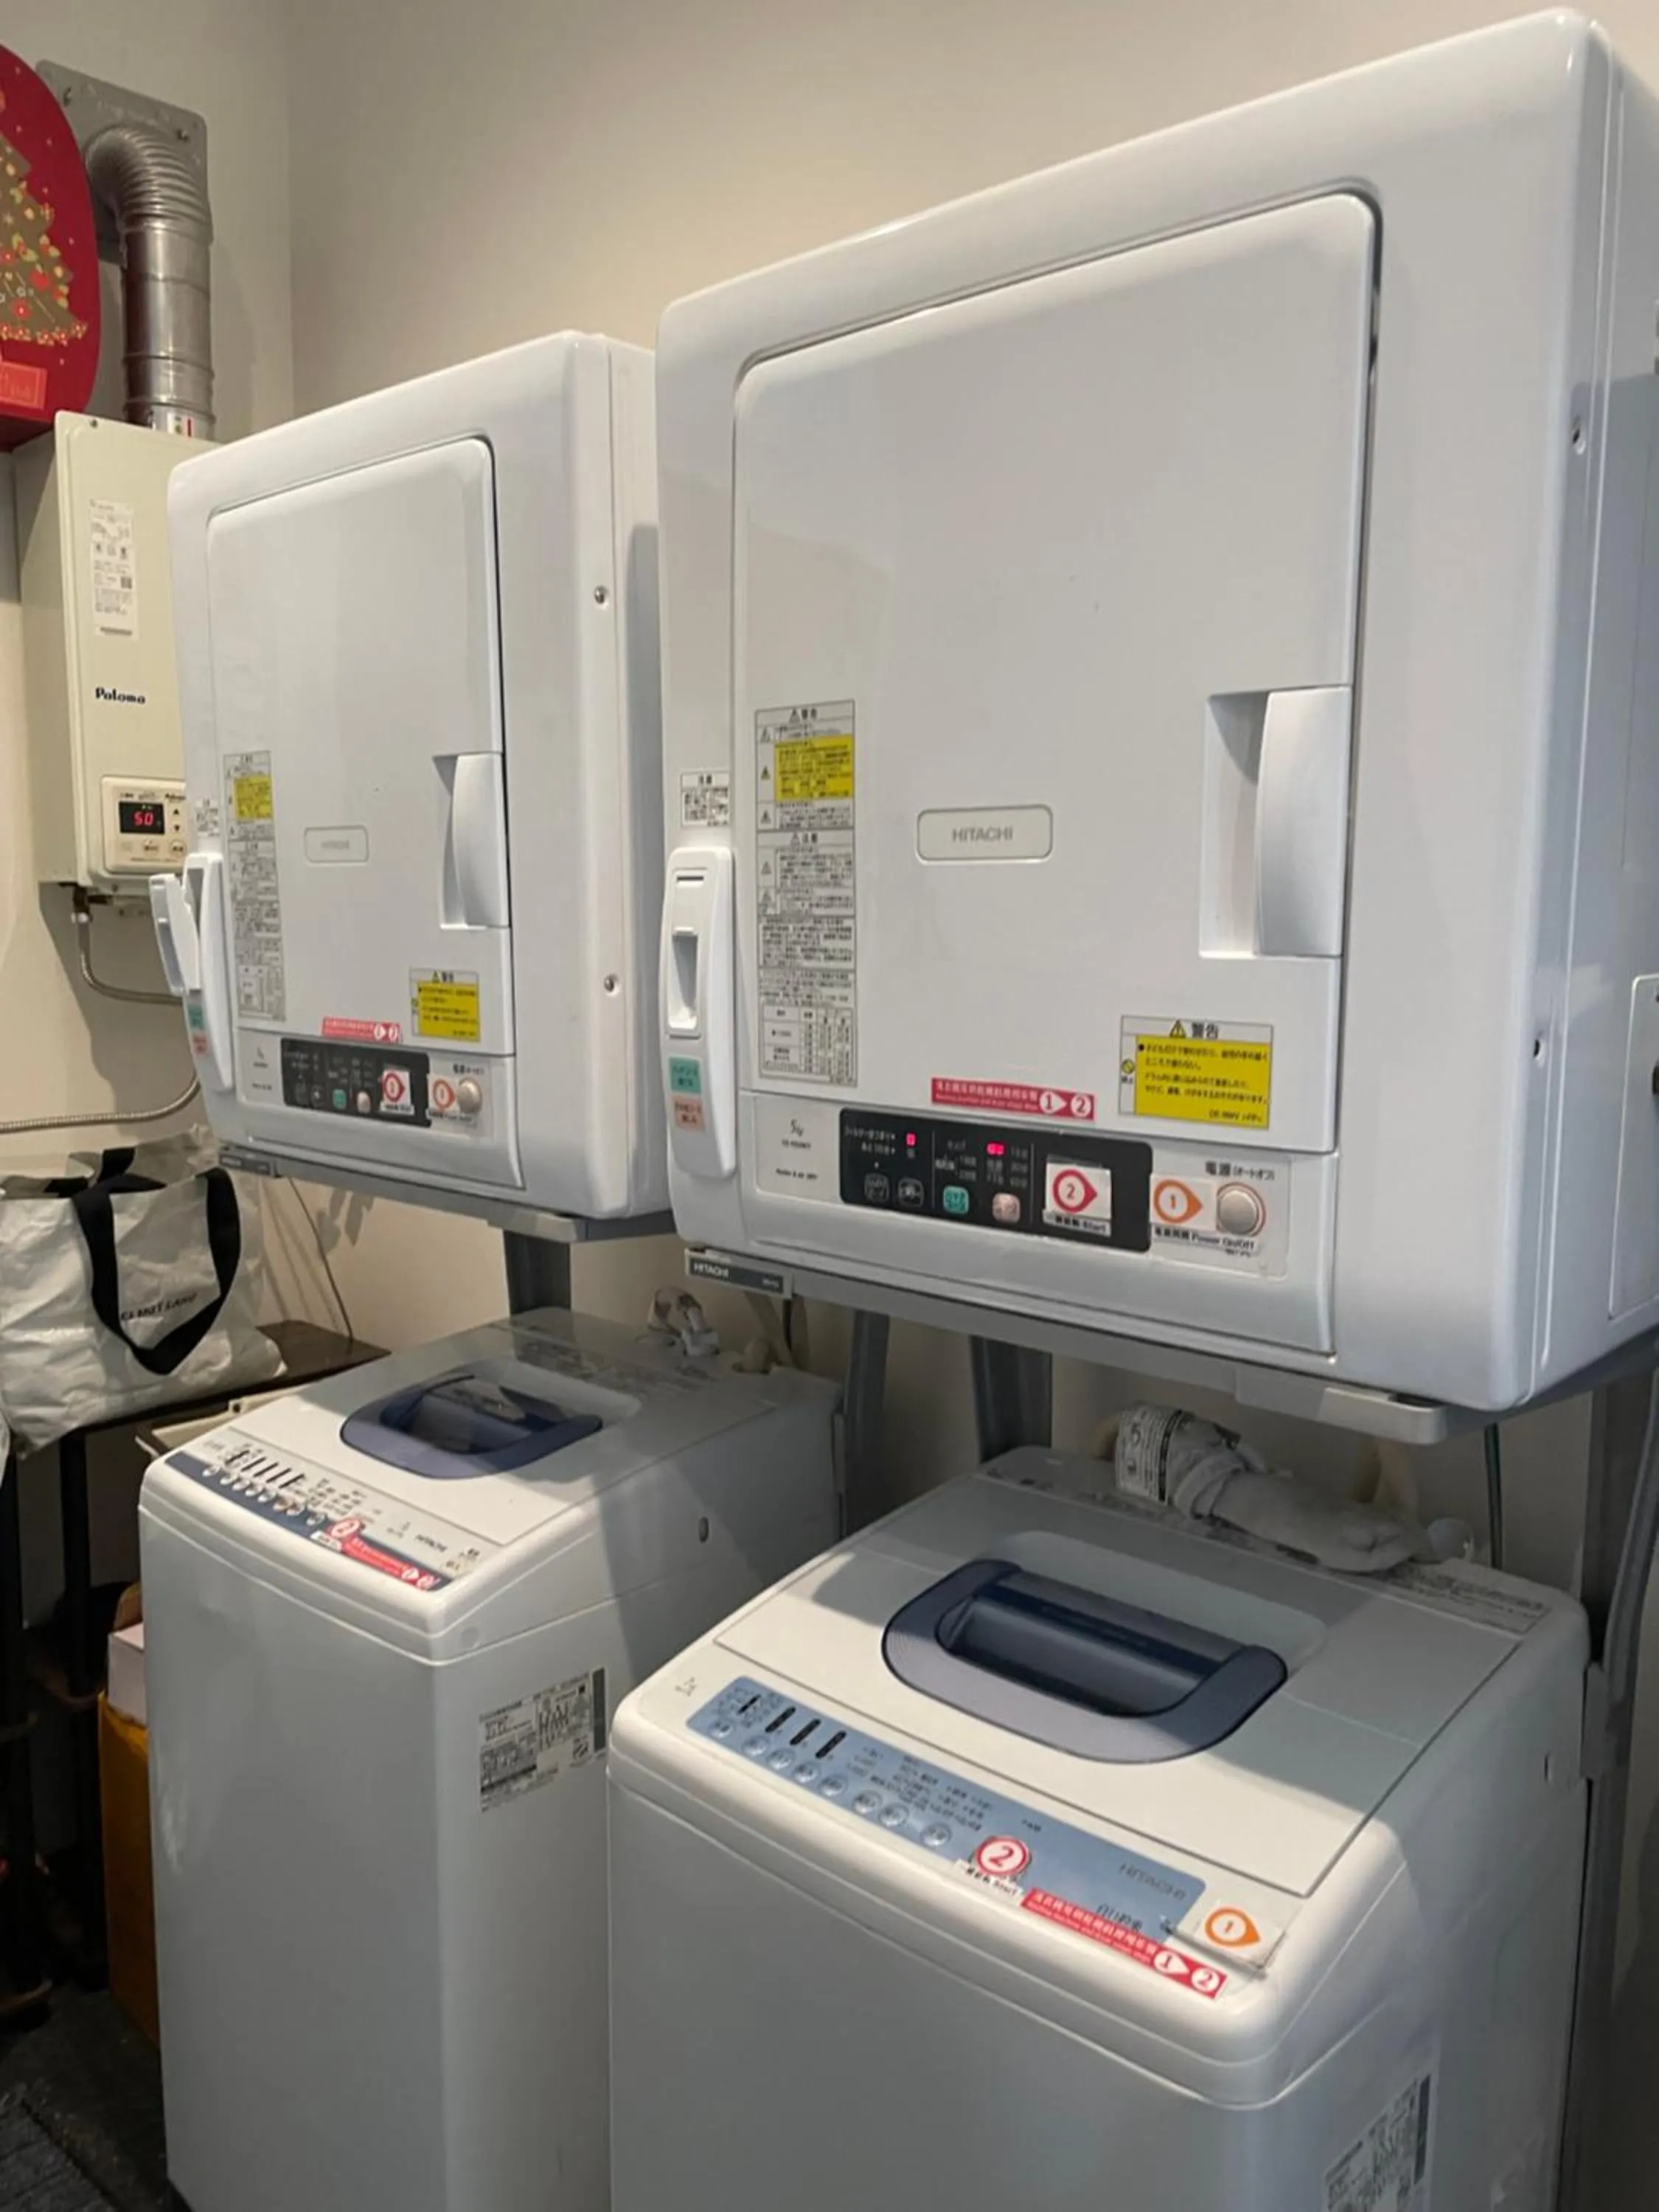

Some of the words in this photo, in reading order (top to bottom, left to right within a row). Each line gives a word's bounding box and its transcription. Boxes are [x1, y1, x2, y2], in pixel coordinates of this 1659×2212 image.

[95, 687, 146, 705] Paloma
[133, 812, 153, 827] 50
[952, 827, 1013, 841] HITACHI
[1192, 1022, 1220, 1040] 警告
[1205, 1161, 1231, 1178] 電源
[1066, 1184, 1075, 1200] 2
[694, 1262, 729, 1279] HITACHI
[988, 1845, 1015, 1868] 2
